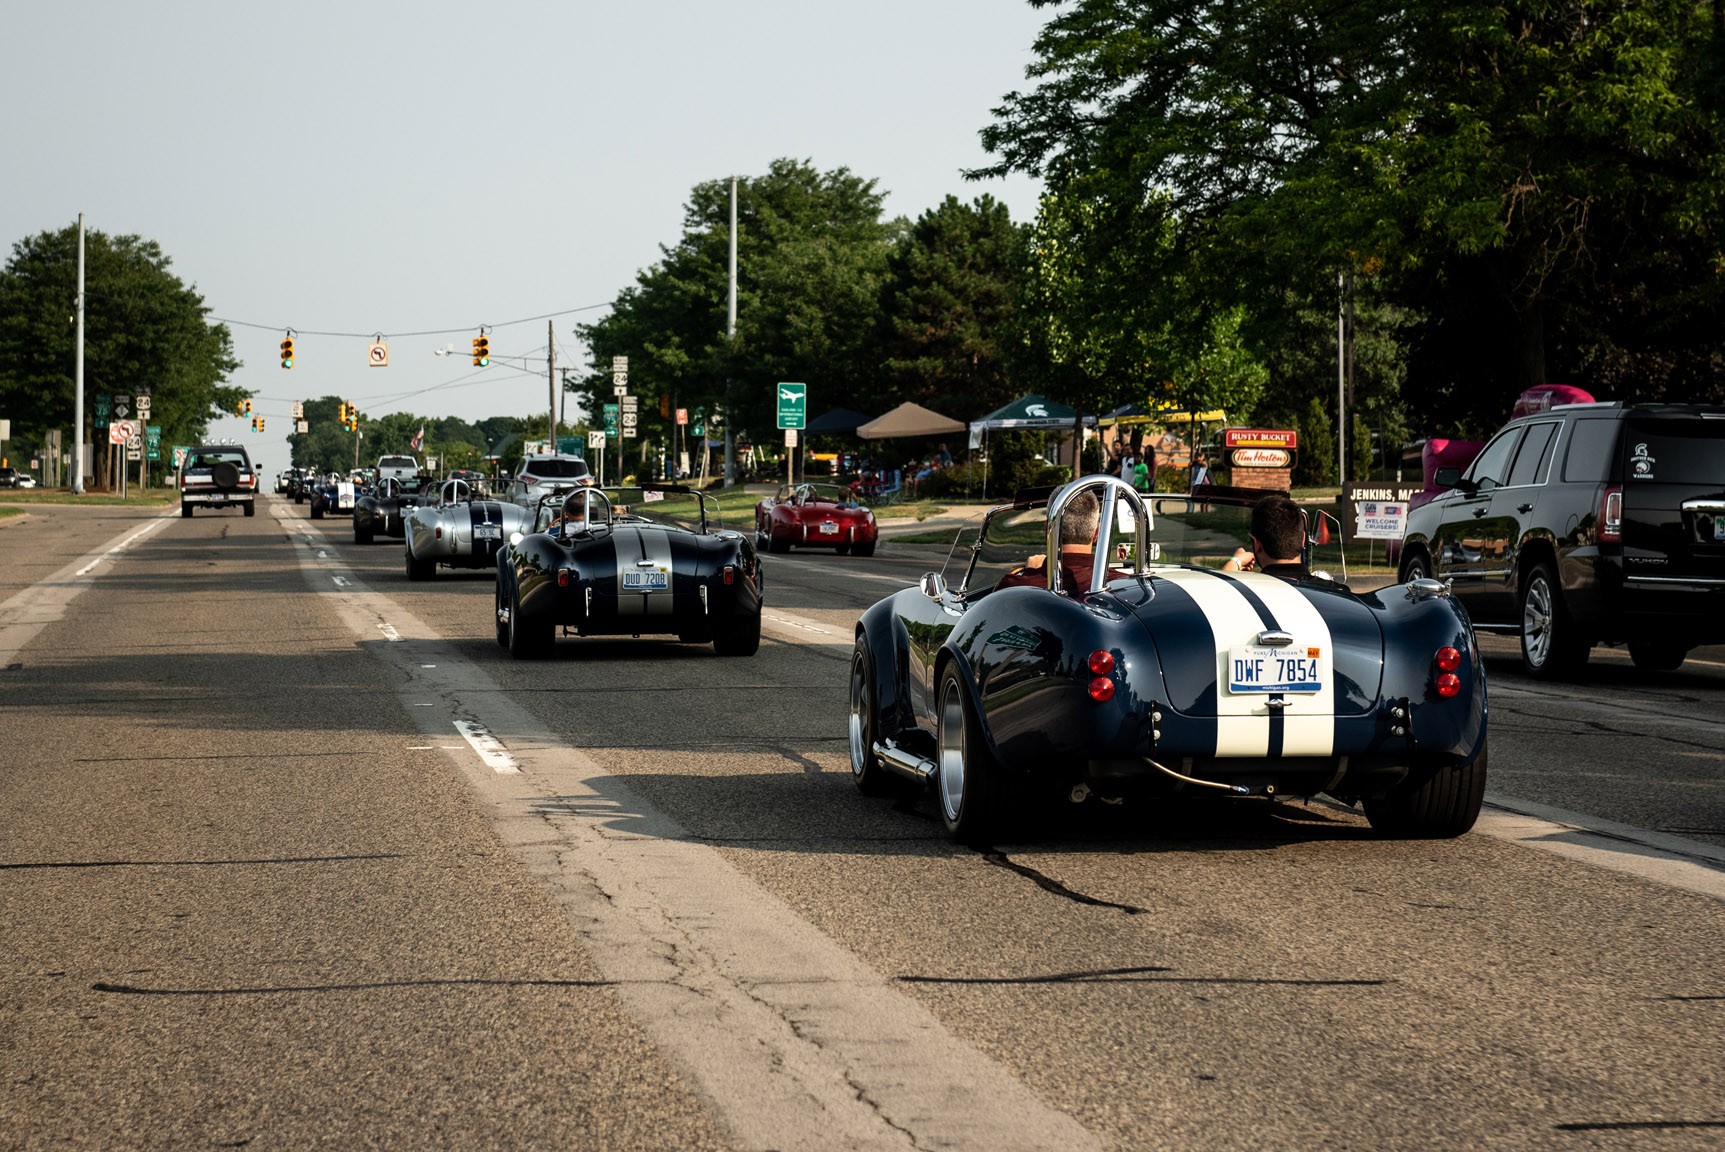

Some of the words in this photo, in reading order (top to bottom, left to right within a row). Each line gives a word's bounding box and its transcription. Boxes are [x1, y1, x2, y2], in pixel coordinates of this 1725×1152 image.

[615, 375, 627, 383] 24
[137, 399, 150, 407] 24
[624, 416, 636, 424] 24
[1261, 433, 1290, 441] BUCKET
[128, 439, 140, 447] 24
[1236, 450, 1253, 461] Tim
[1253, 451, 1287, 462] Hortons
[1350, 488, 1395, 502] JENKINS,
[625, 573, 640, 585] DUD
[645, 572, 666, 585] 7208
[1266, 648, 1298, 657] MICHIGAN
[1234, 659, 1264, 682] DWF
[1276, 659, 1317, 682] 7854
